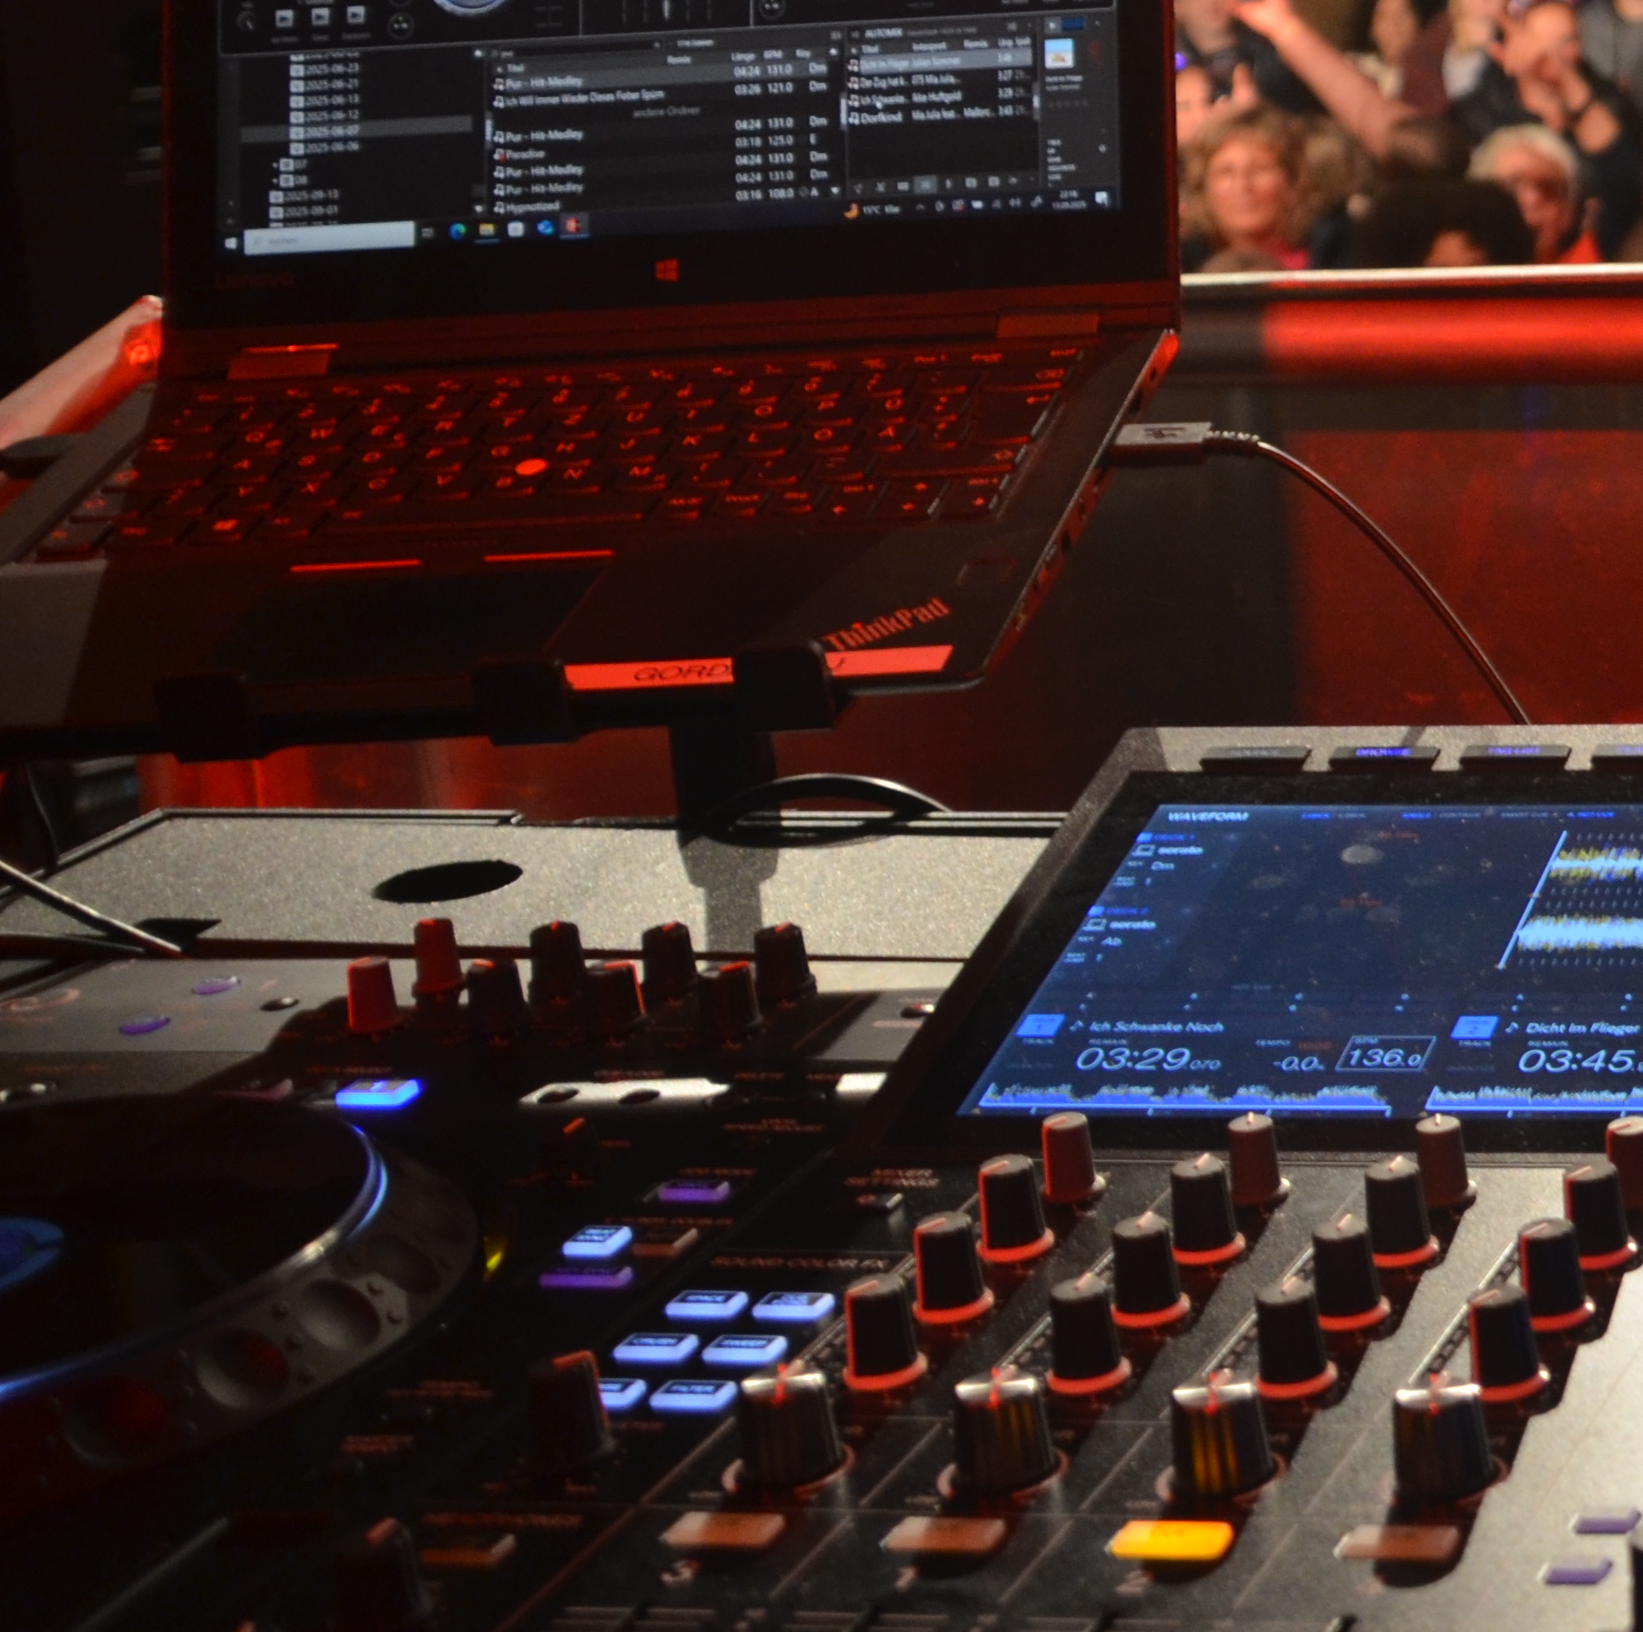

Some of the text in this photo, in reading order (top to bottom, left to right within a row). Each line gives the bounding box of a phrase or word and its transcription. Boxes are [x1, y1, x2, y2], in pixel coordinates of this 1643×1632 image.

[734, 63, 827, 78] 04:24 131.0 Dm
[809, 81, 827, 92] Dm
[735, 119, 762, 131] 04:24
[768, 117, 794, 128] 131.0
[810, 116, 828, 127] Dm
[735, 155, 762, 166] 04:24
[768, 153, 794, 164] 131.0
[214, 270, 295, 289] Lenovo
[822, 597, 951, 651] ThinkPad
[634, 663, 734, 682] GORD
[1167, 811, 1249, 822] WAVEFORM
[1156, 846, 1203, 856] serato
[1109, 920, 1156, 930] serato
[1089, 1021, 1224, 1034] Ich Schwanke Noch
[1526, 1022, 1564, 1034] Dicht
[1590, 1022, 1642, 1037] Flieger
[1348, 1048, 1421, 1068] 136.0
[711, 1256, 890, 1269] SOUND COLOR FX
[669, 1384, 717, 1393] FILTER
